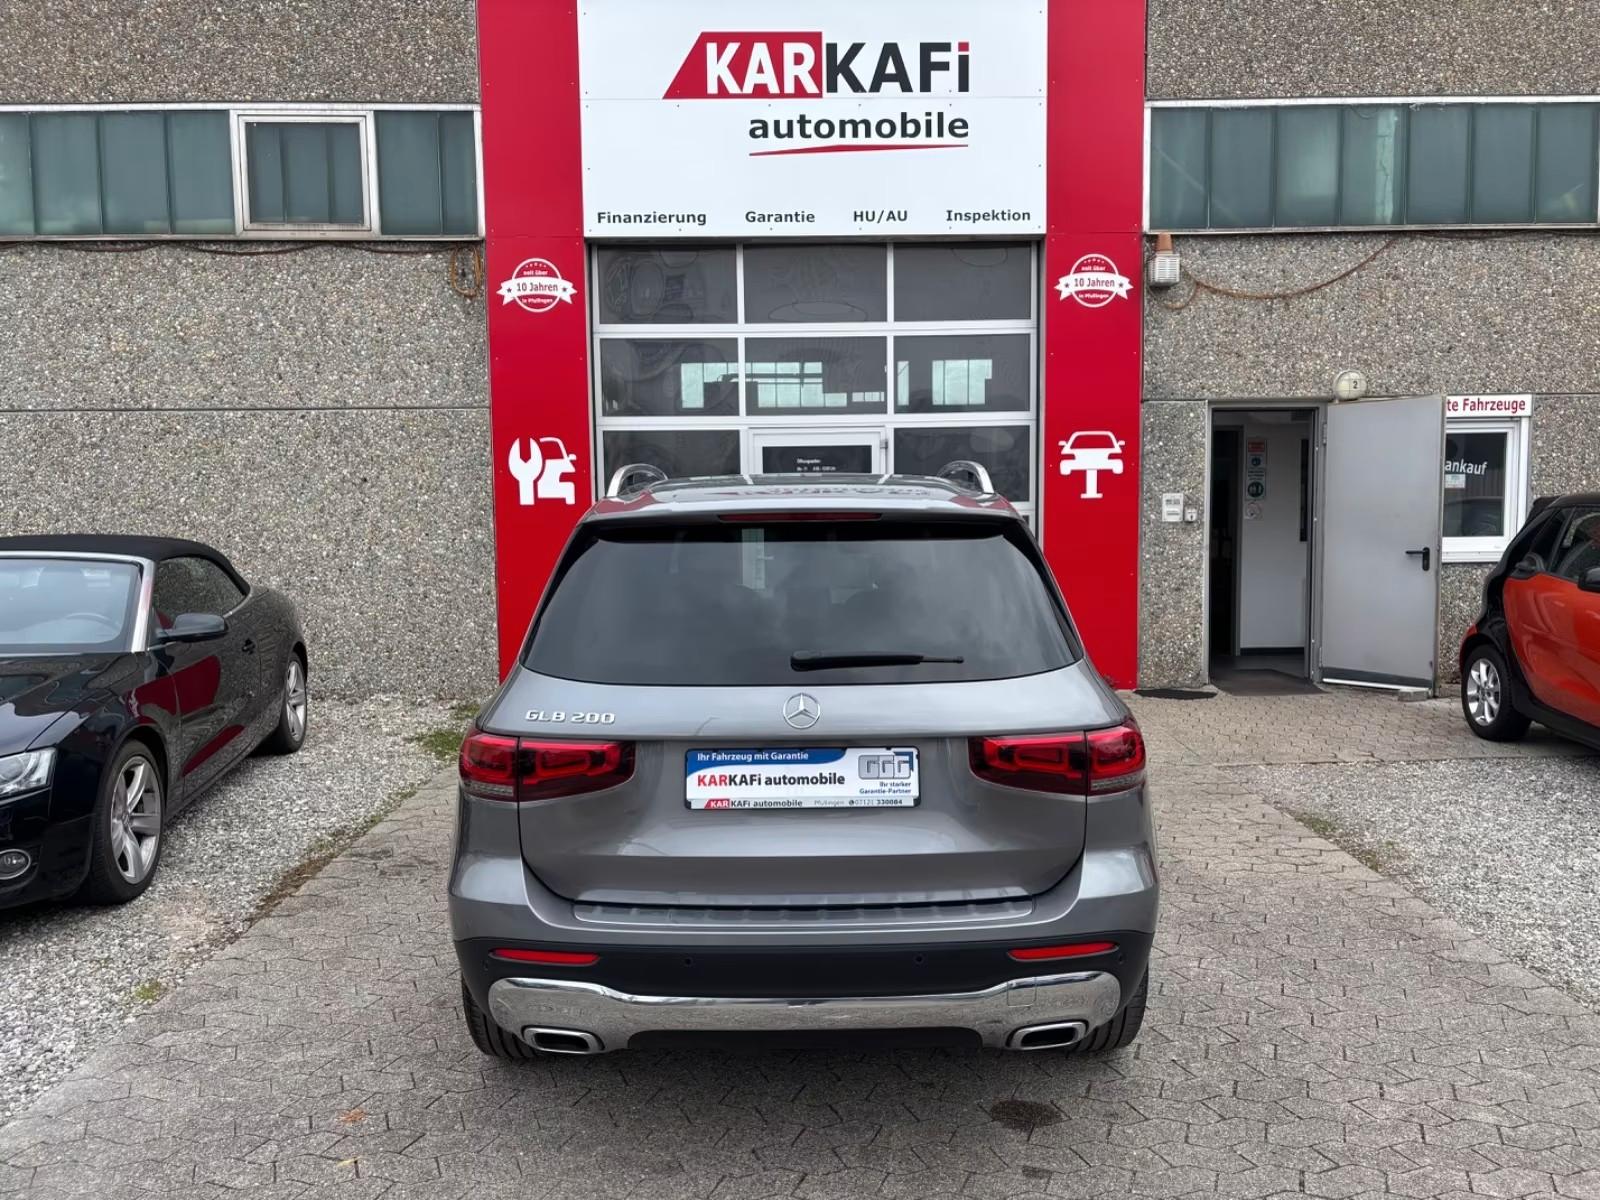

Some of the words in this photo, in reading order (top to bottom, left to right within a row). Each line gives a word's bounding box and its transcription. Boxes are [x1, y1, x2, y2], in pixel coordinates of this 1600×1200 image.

[705, 41, 970, 94] KARKAFi
[748, 112, 969, 139] automobile
[597, 211, 707, 225] Finanzierung
[745, 211, 815, 223] Garantie
[853, 210, 908, 223] HU/AU
[946, 209, 1031, 223] Inspektion
[517, 282, 527, 291] 10
[529, 282, 558, 292] Jahren
[1074, 278, 1084, 287] 10
[1086, 278, 1115, 287] Jahren
[1352, 380, 1359, 390] 2
[1462, 397, 1526, 414] Fahrzeuge
[525, 709, 566, 721] GLB
[570, 712, 616, 724] 200
[697, 752, 710, 761] Ihr
[711, 752, 753, 762] Fahrzeug
[754, 752, 770, 760] mit
[771, 751, 809, 760] Garantie
[697, 774, 761, 787] KARKAFi
[764, 772, 846, 786] automobile
[710, 800, 751, 808] KARKAFi
[753, 799, 803, 807] automobile
